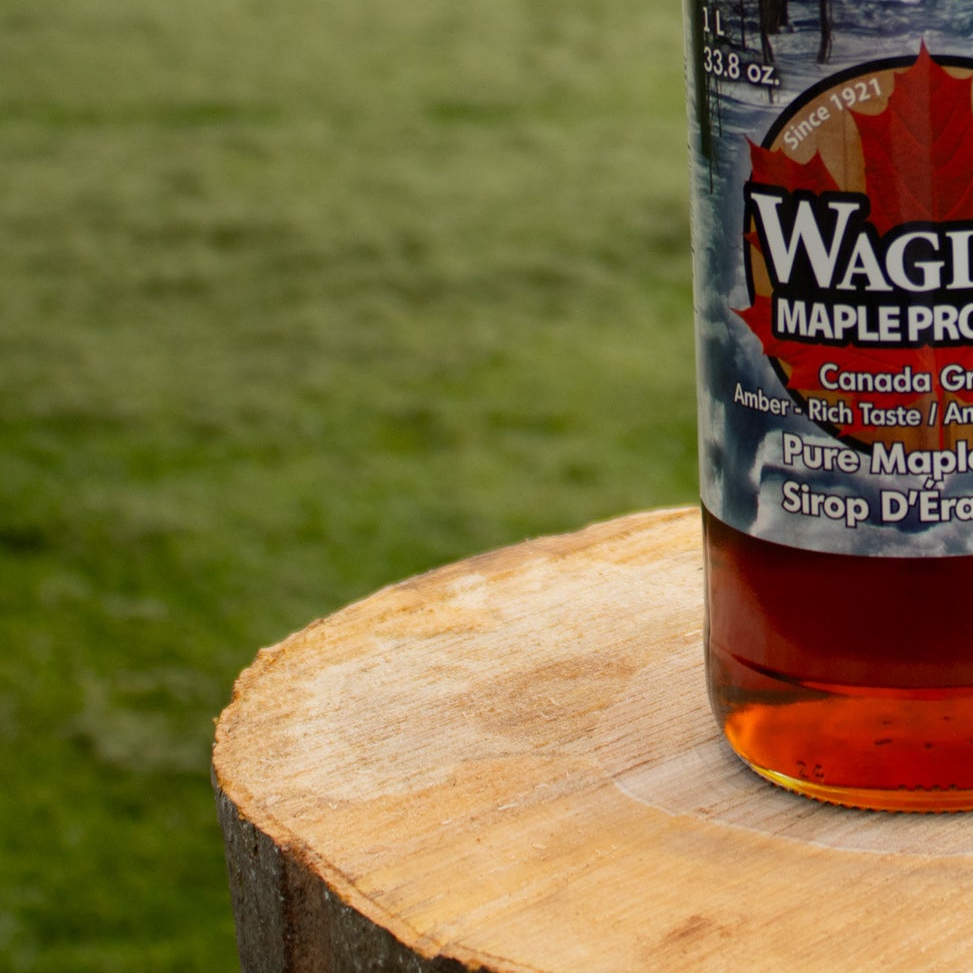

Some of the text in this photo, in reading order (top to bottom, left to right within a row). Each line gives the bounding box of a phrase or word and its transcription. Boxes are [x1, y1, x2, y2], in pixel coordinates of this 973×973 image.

[702, 6, 724, 36] 1 L
[703, 46, 780, 86] 33.8 oz.
[784, 78, 881, 150] Since 1921
[778, 298, 900, 341] MAPLE
[819, 363, 931, 393] Canada
[734, 382, 790, 416] Amber
[808, 400, 852, 425] Rich
[859, 402, 921, 427] Taste
[783, 433, 860, 473] Pure
[782, 481, 869, 528] Sirop
